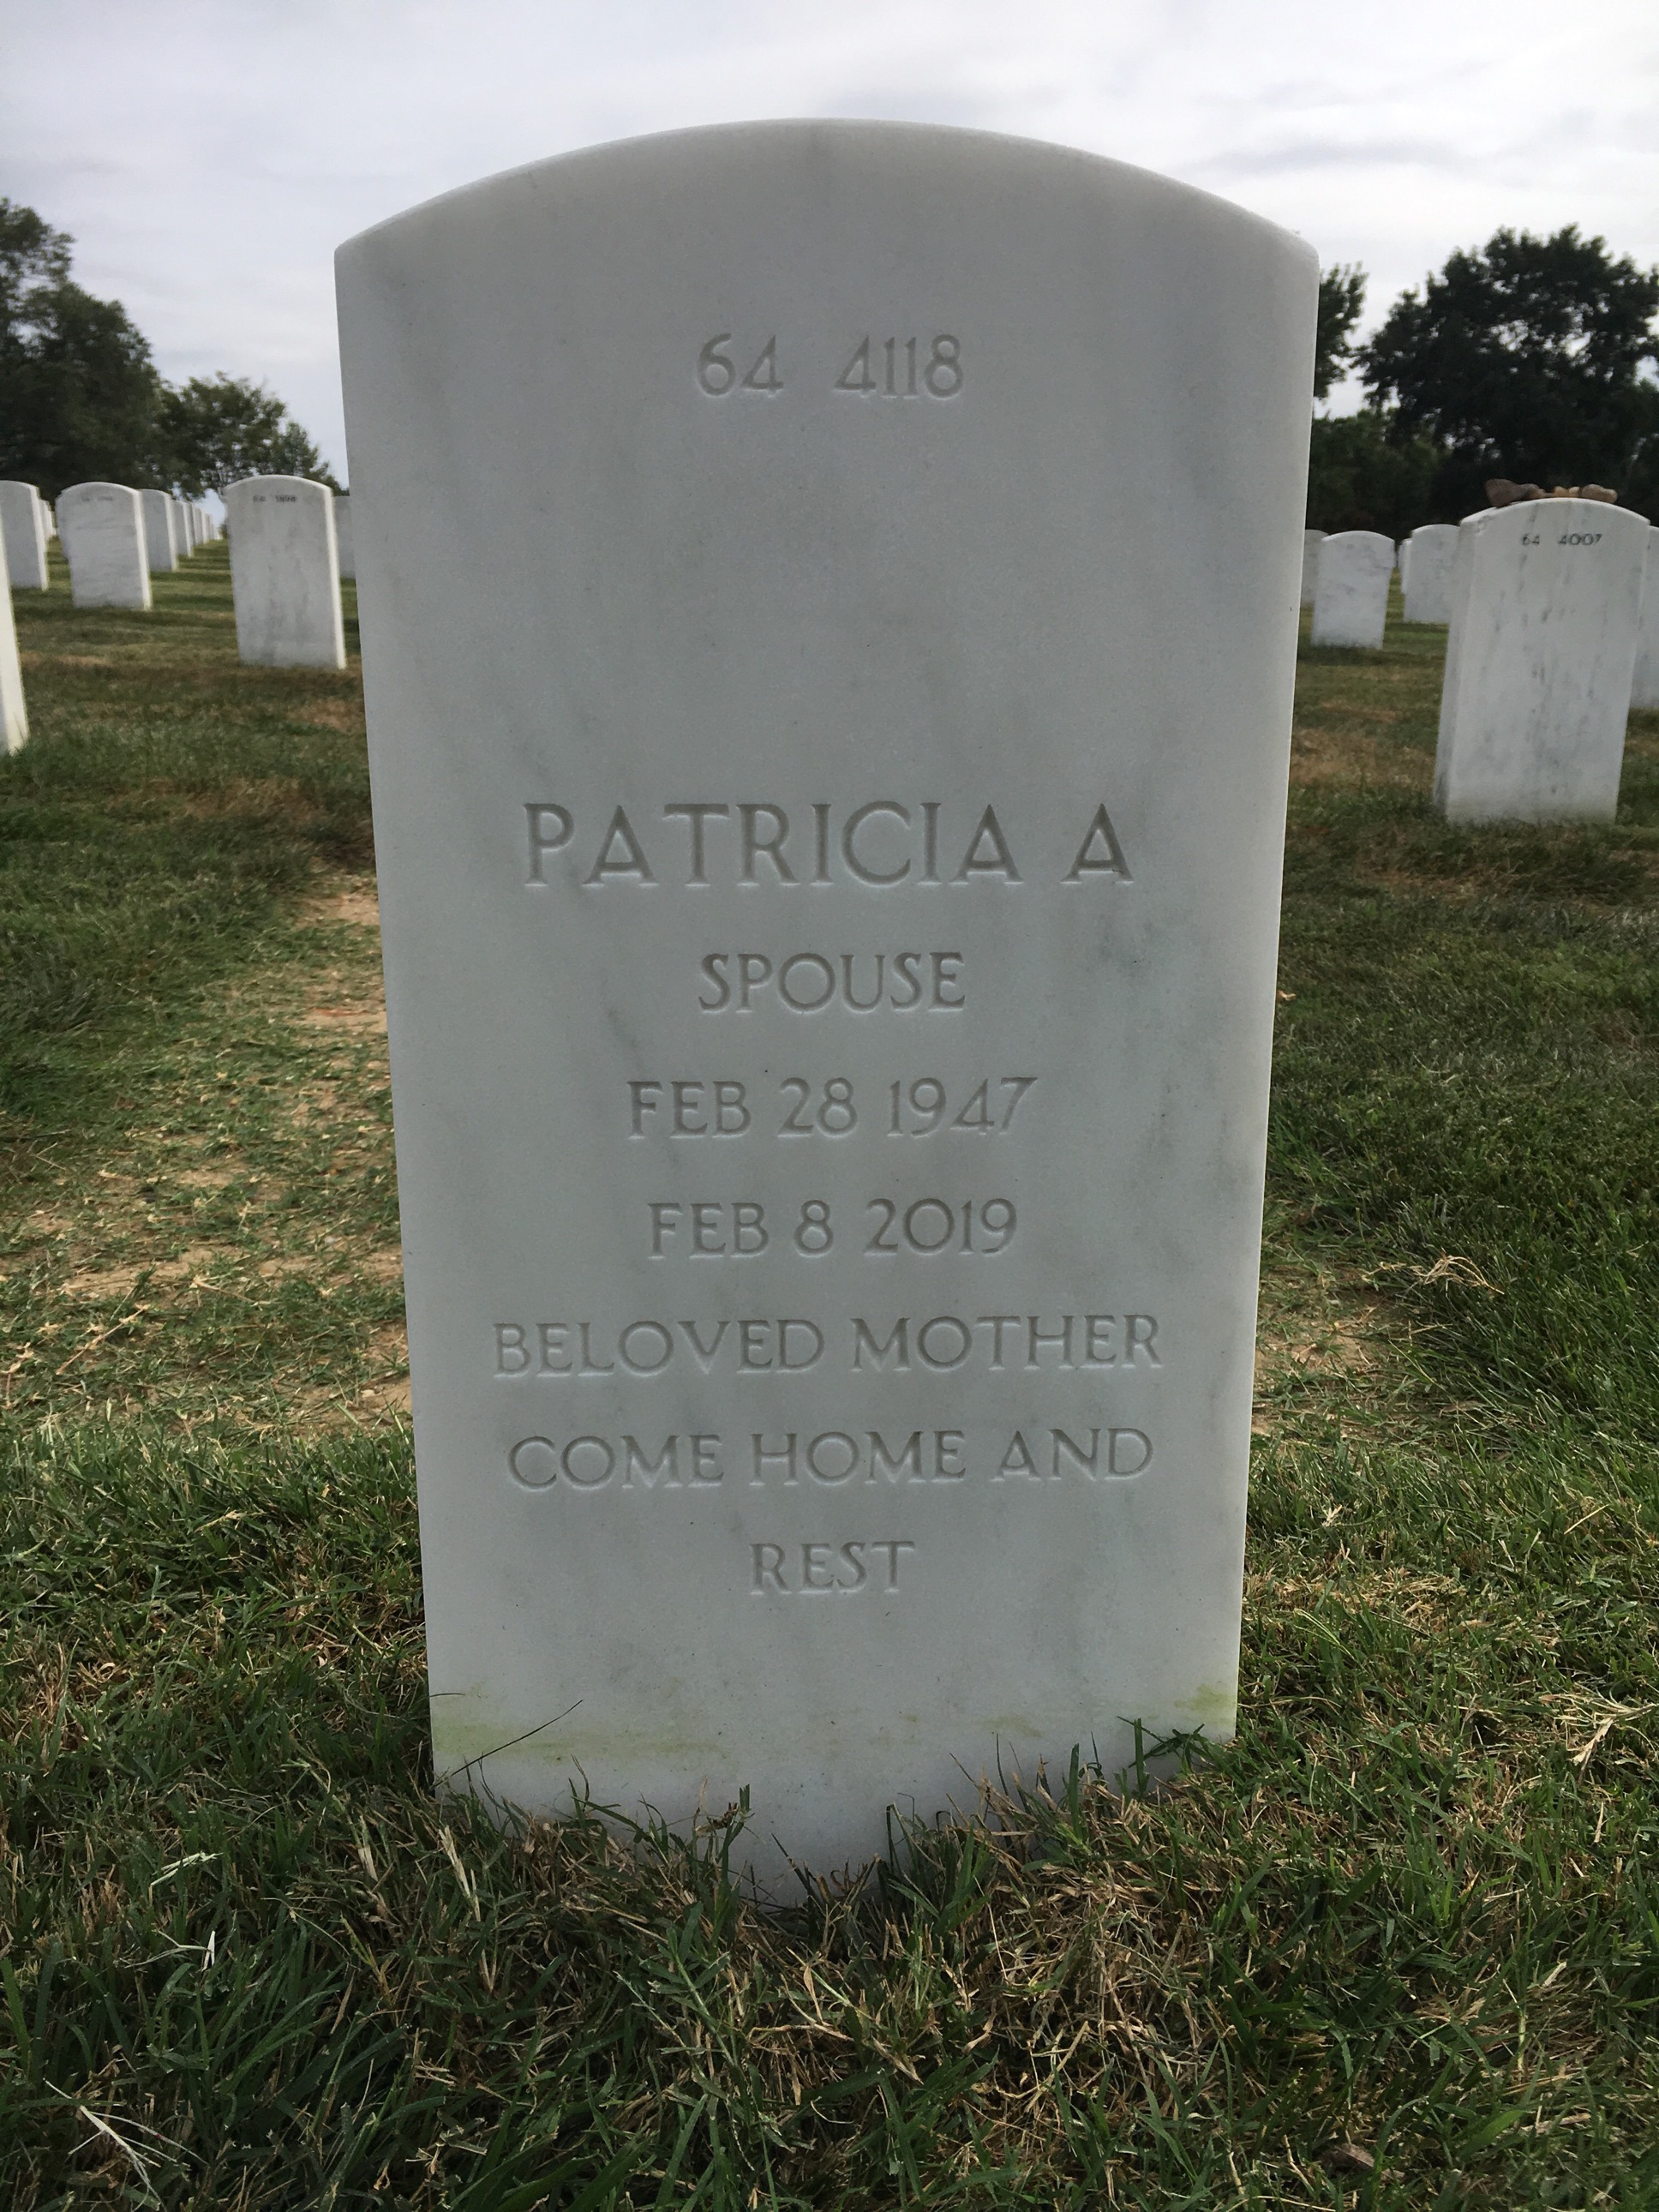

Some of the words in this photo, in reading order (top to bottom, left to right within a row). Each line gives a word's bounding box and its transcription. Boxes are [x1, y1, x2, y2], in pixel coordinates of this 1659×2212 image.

[697, 332, 784, 398] 64
[833, 333, 964, 399] 4118
[1522, 532, 1541, 546] 64
[524, 801, 1024, 887] PATRICIA
[1060, 801, 1135, 884] A
[697, 950, 967, 1014] SPOUSE
[626, 1079, 752, 1140] FEB
[776, 1076, 858, 1139] 28
[886, 1076, 1039, 1138] 1947
[647, 1202, 771, 1261] FEB
[792, 1199, 835, 1259] 8
[862, 1197, 1018, 1257] 2019
[492, 1318, 826, 1379] BELOVED
[850, 1313, 1165, 1374] MOTHER
[506, 1433, 726, 1492] COME
[747, 1429, 968, 1489] HOME
[989, 1426, 1155, 1485] AND
[748, 1539, 917, 1598] REST
